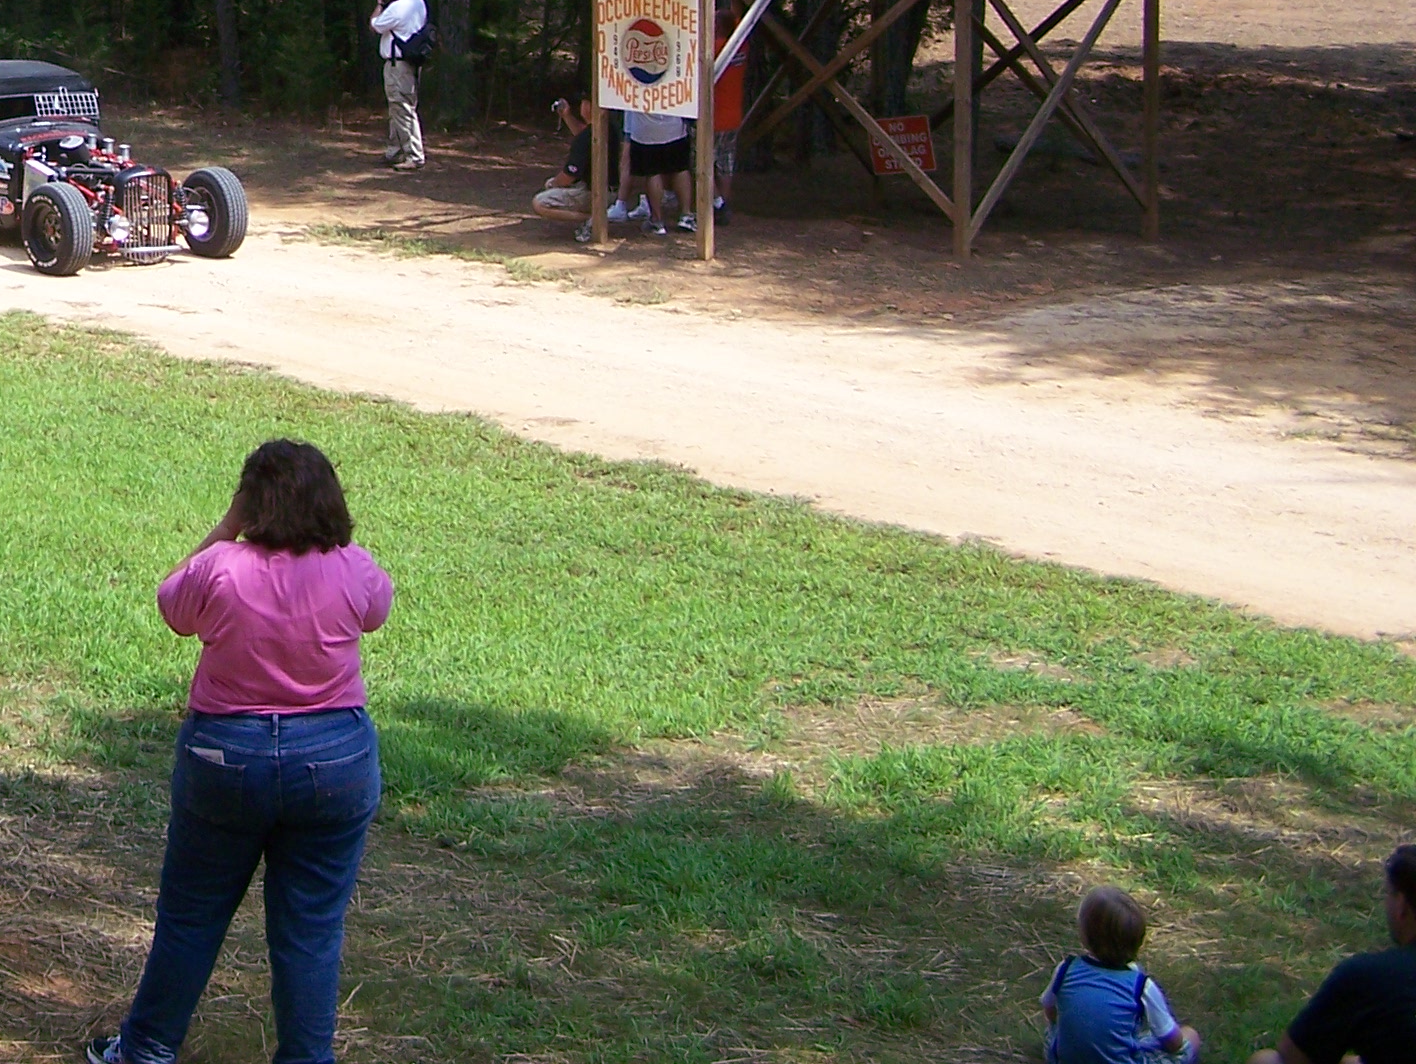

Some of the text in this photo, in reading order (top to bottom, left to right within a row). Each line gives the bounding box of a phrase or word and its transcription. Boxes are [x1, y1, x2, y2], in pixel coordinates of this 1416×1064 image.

[598, 30, 639, 109] ORANGE
[643, 38, 696, 113] SPEEDWAY
[888, 122, 905, 133] NO
[885, 157, 923, 170] STD
